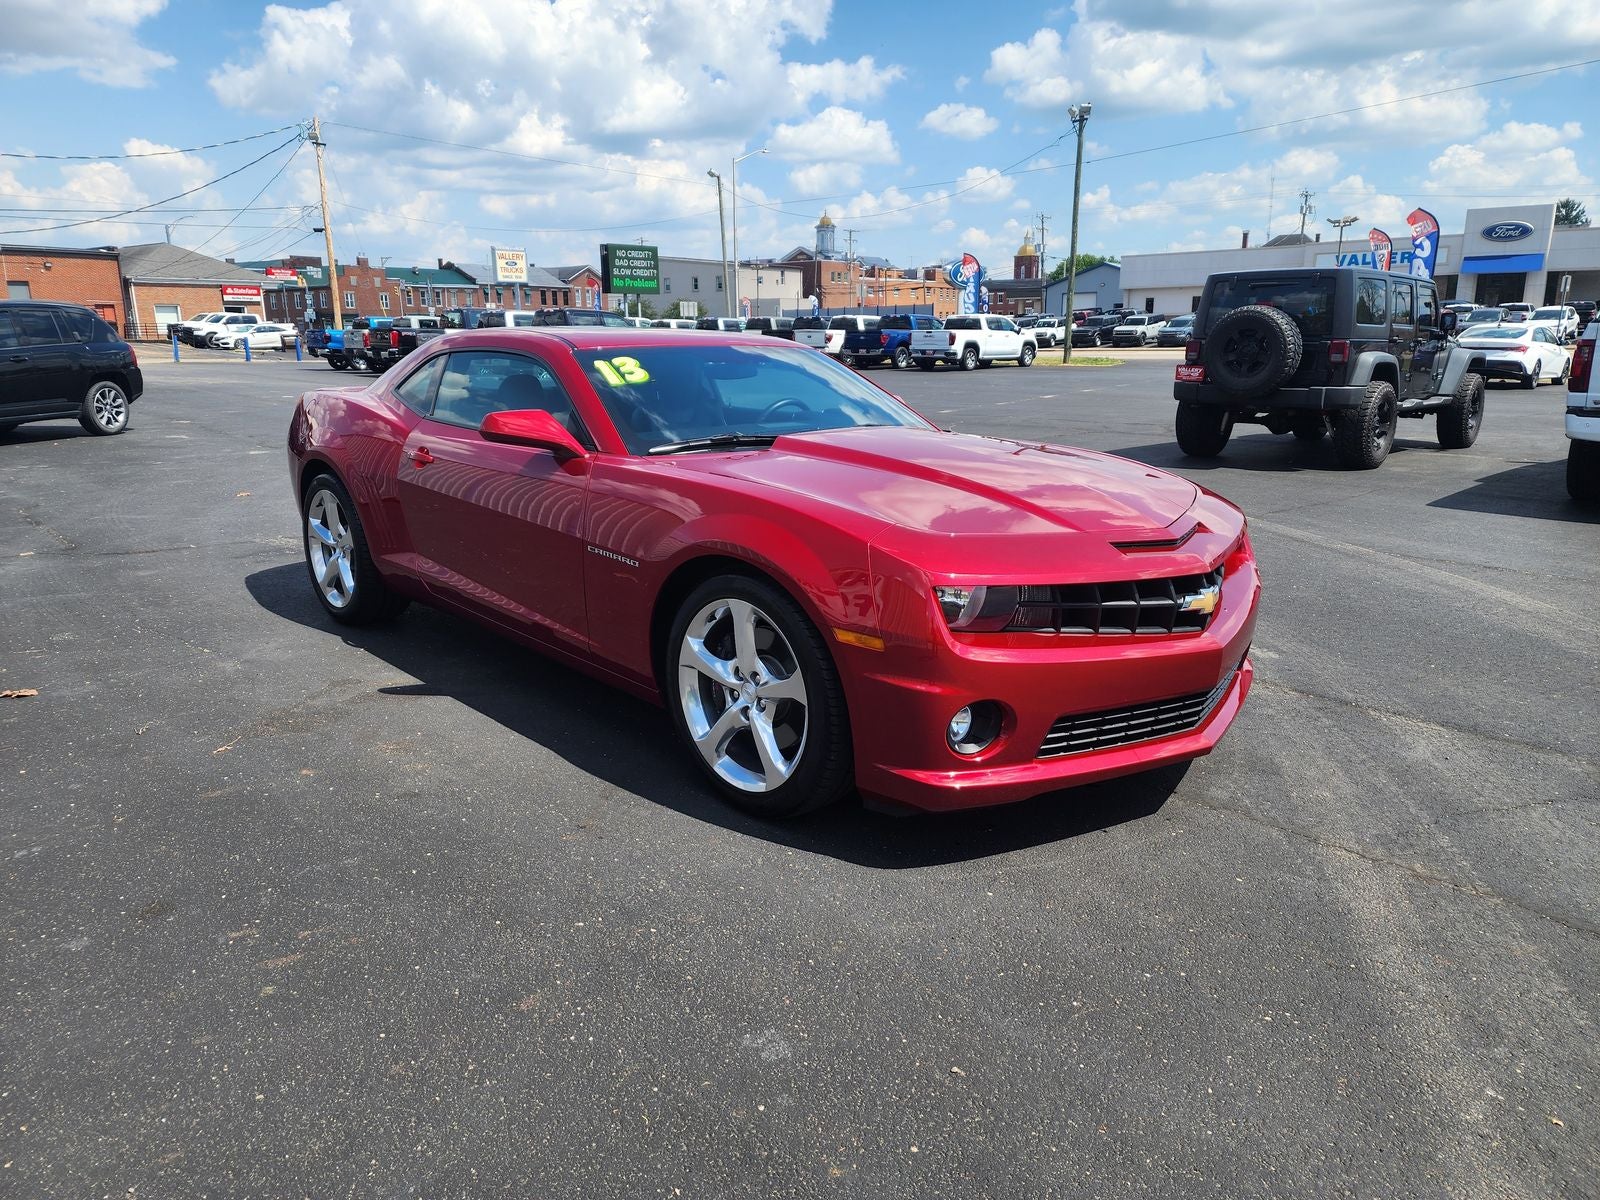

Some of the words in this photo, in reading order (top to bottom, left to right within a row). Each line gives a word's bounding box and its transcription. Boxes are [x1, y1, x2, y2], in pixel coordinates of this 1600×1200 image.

[1492, 225, 1522, 237] Ford
[497, 252, 524, 261] VALLERY
[616, 249, 626, 257] NO
[627, 250, 652, 258] CREDIT?
[615, 258, 628, 266] BAD
[1335, 250, 1414, 267] VALER
[500, 266, 524, 274] TRUCKS
[632, 269, 657, 277] CREDIT?
[613, 278, 624, 286] No
[625, 279, 657, 288] Problem!
[593, 356, 650, 388] 13
[588, 545, 639, 567] CAMARO
